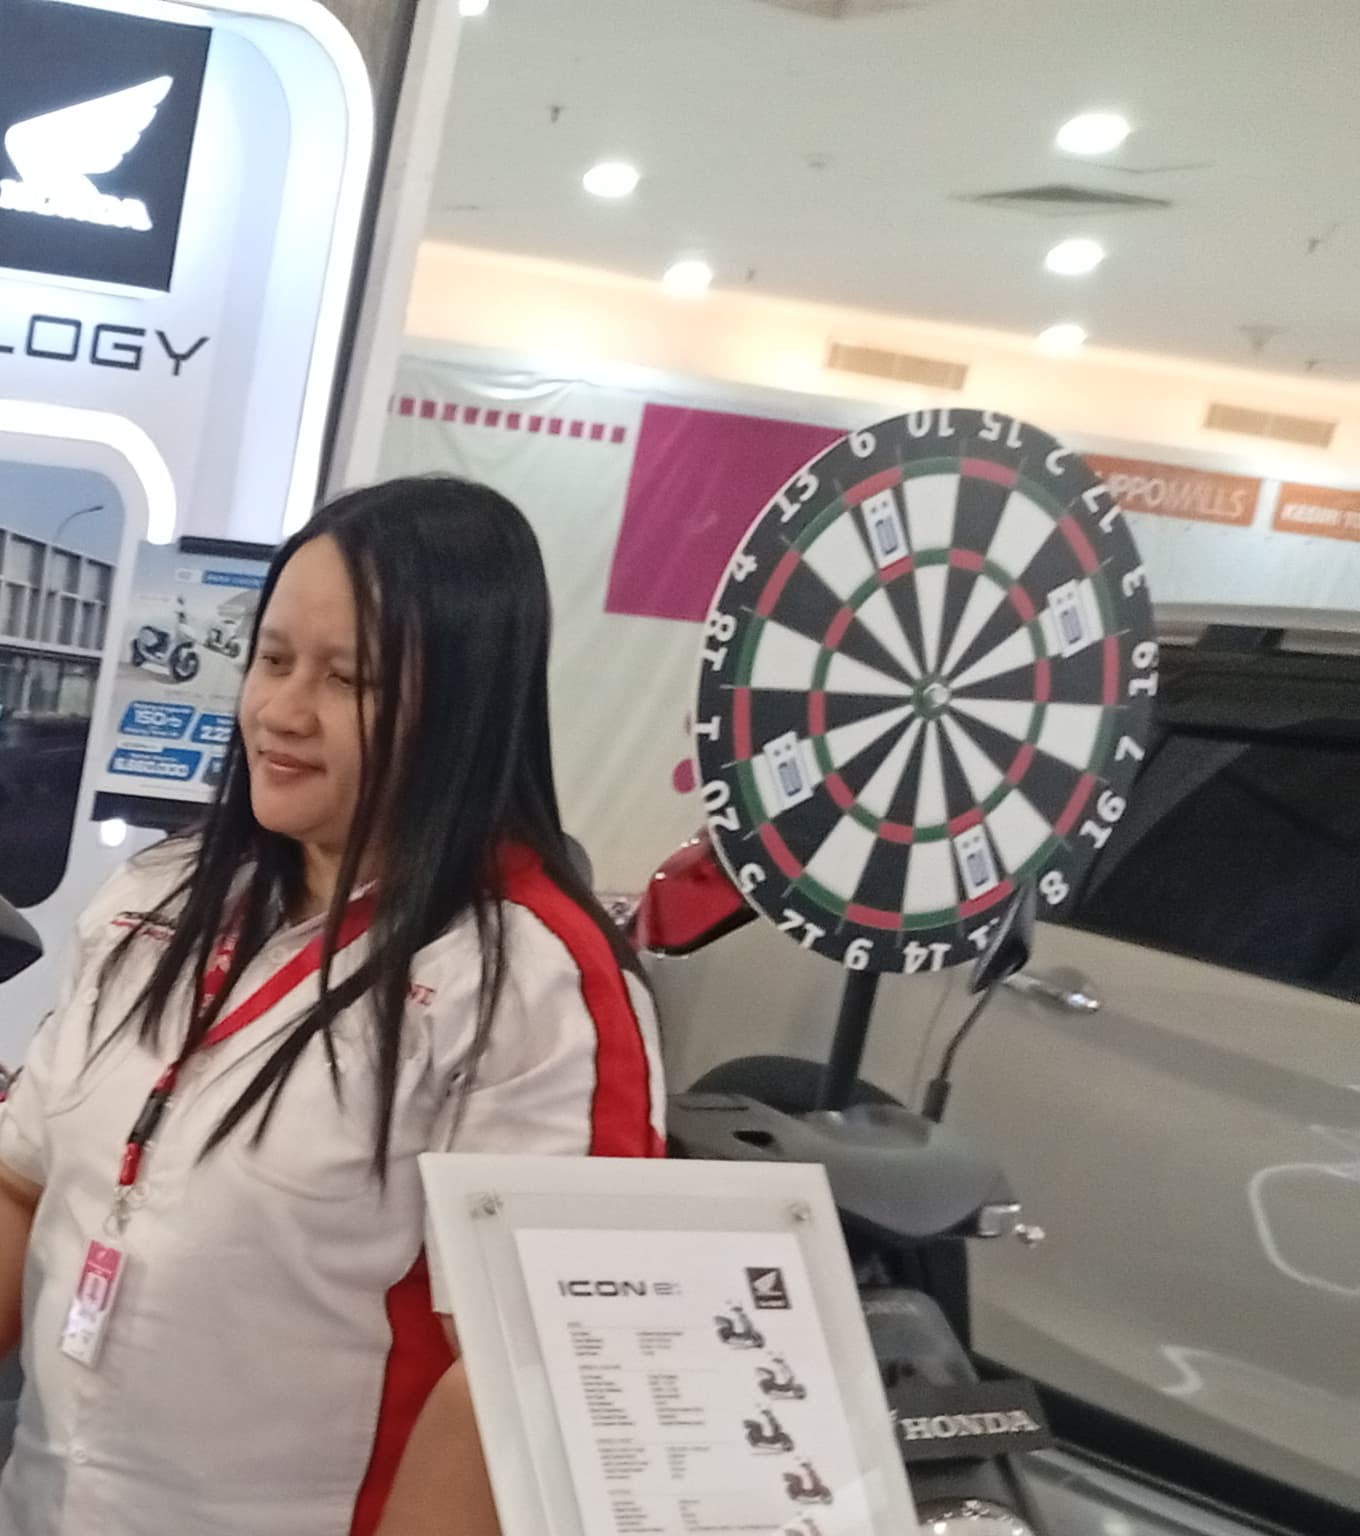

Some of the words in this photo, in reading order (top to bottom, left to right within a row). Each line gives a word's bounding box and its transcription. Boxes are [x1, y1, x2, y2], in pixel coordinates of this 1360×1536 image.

[1114, 735, 1145, 761] 7
[1080, 789, 1127, 849] 16
[738, 862, 768, 894] 5
[1039, 869, 1070, 906] 8
[557, 1280, 647, 1297] ICON
[901, 1409, 1041, 1441] HONDA
